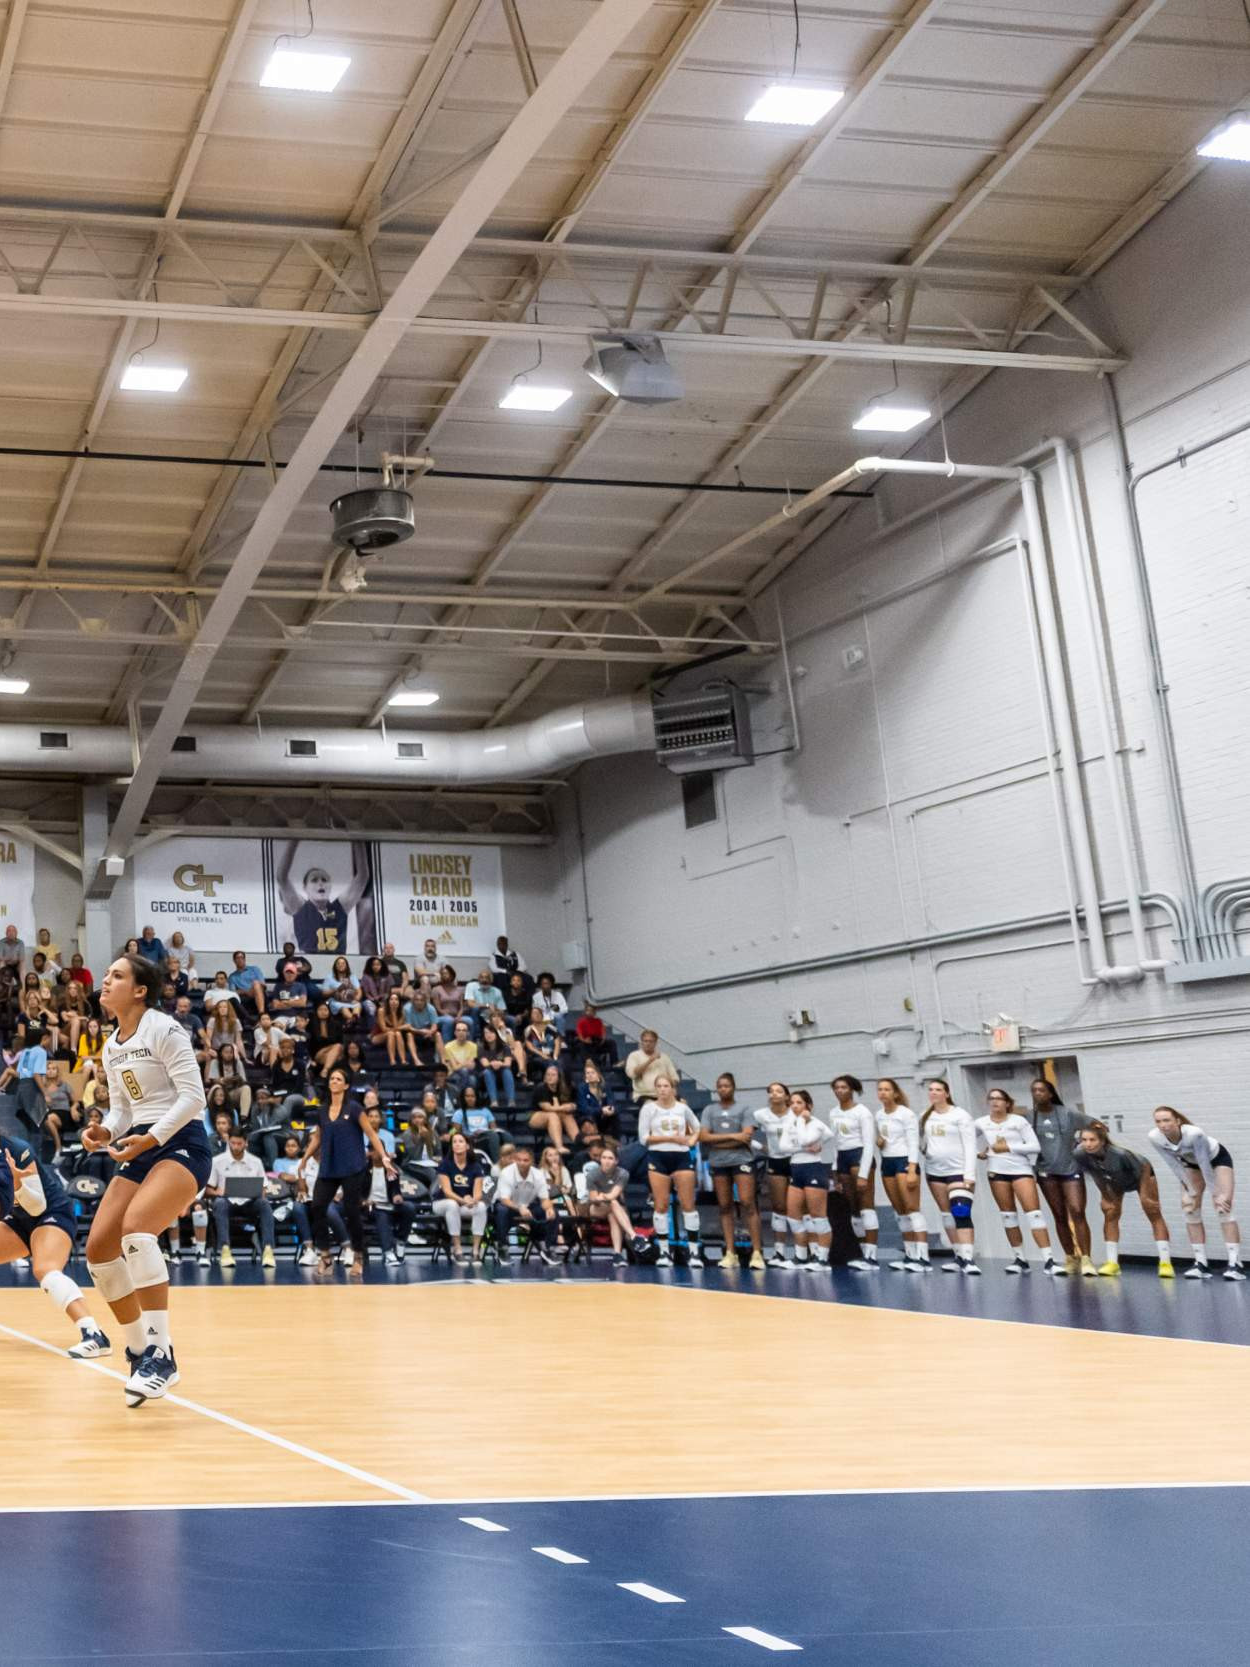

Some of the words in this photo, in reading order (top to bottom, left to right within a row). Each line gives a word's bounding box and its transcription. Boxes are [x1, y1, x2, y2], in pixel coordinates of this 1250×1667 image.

[410, 854, 472, 875] LINDSEY
[412, 877, 472, 897] LABAND
[150, 900, 207, 914] GEORGIA
[212, 902, 248, 915] TECH
[409, 900, 437, 912] 2004
[450, 901, 478, 913] 2005
[410, 914, 479, 928] ALL-AMERICAN
[316, 927, 338, 951] 15
[121, 1069, 144, 1101] 8
